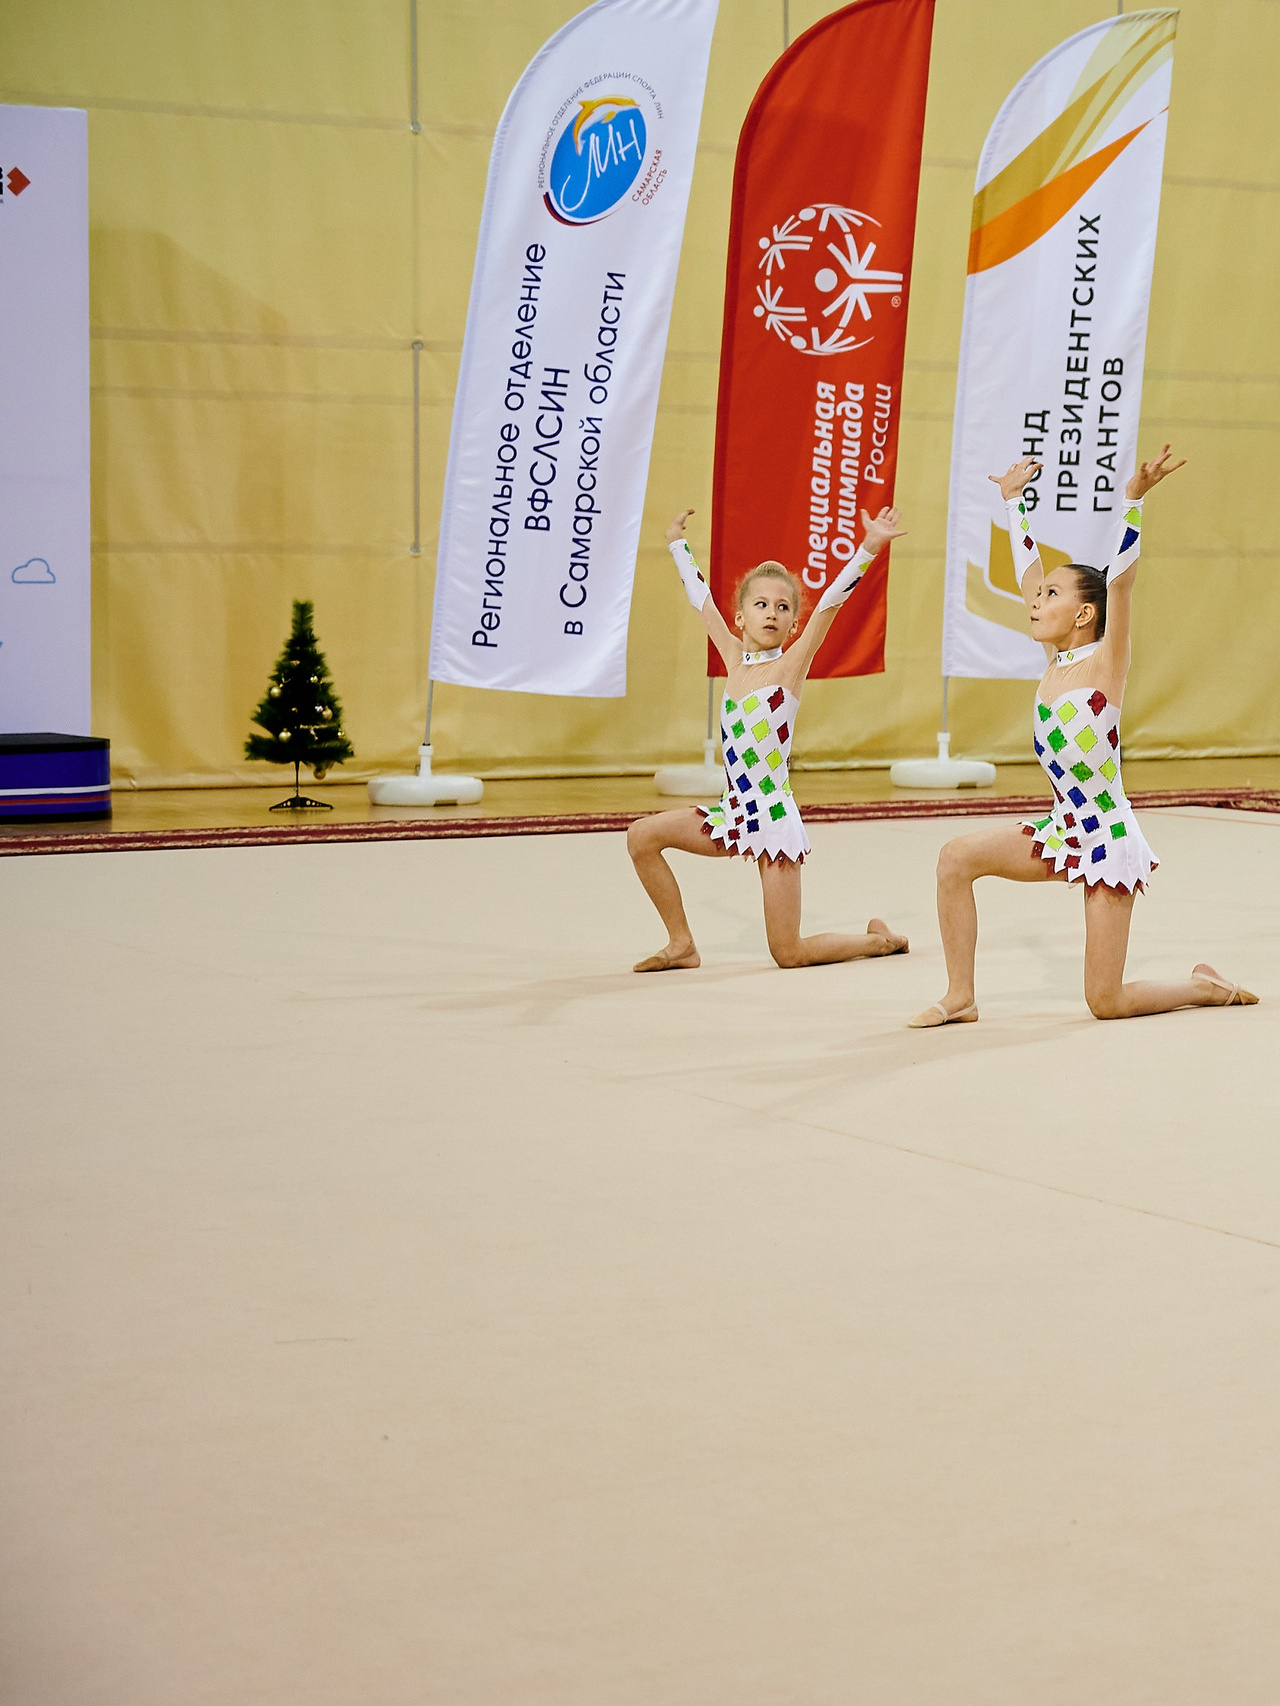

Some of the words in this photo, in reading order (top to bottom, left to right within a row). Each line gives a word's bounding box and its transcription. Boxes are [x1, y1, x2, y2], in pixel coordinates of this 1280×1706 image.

[538, 126, 556, 188] РЕГИОНАЛЬНОЕ
[553, 87, 584, 126] ОТДЕЛЕНИЕ
[584, 71, 632, 89] ФЕДЕРАЦИИ
[632, 74, 657, 100] СПОРТА
[653, 101, 664, 120] ЛИН
[631, 149, 663, 202] САМАРСКАЯ
[641, 169, 668, 206] ОБЛАСТЬ
[584, 271, 626, 404] области
[1056, 214, 1102, 512] ПРЕЗИДЕНТСКИХ
[472, 423, 520, 648] Региональное
[504, 243, 546, 411] отделение
[524, 367, 570, 532] ВФСЛСИН
[802, 381, 836, 589] Специальная
[831, 382, 864, 561] Олимпиада
[864, 383, 892, 484] России
[1093, 357, 1124, 512] ГРАНТОВ
[559, 417, 603, 608] Самарской
[564, 620, 583, 635] в
